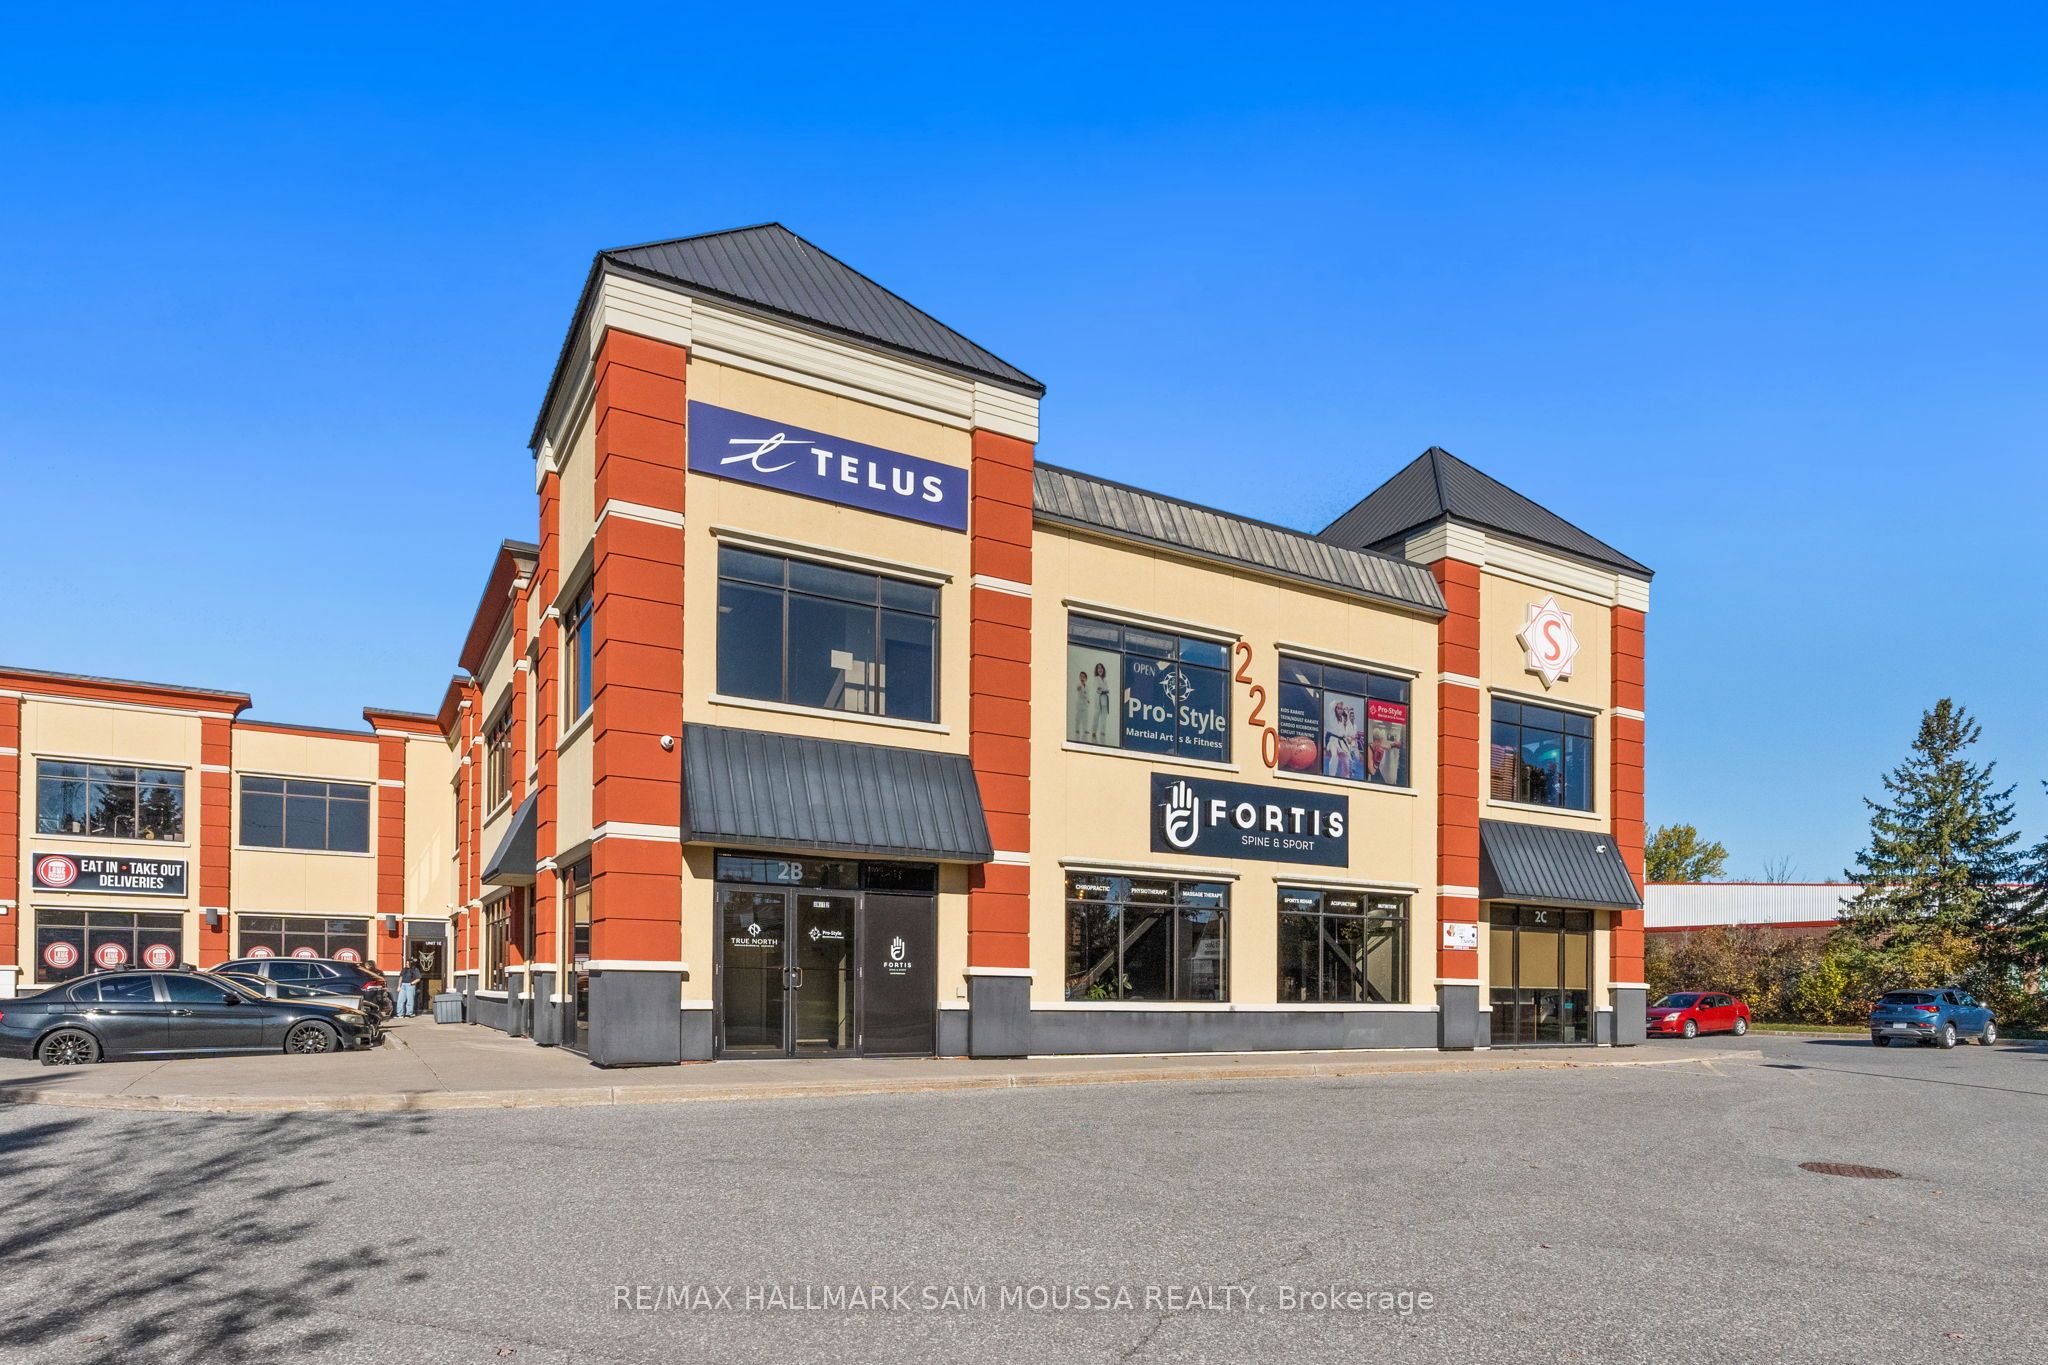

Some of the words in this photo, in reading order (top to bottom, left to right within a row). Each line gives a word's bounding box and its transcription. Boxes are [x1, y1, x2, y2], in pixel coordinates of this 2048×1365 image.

[811, 447, 943, 503] TELUS
[1544, 619, 1561, 661] S
[1133, 662, 1156, 677] OPEN
[1377, 705, 1402, 716] Pro-Style
[1126, 727, 1158, 740] Martial
[1185, 736, 1192, 744] &
[1193, 736, 1223, 749] Fitness
[1211, 799, 1344, 838] FORTIS
[1241, 835, 1270, 847] SPINE
[1273, 839, 1280, 848] &
[1282, 840, 1315, 851] SPORT
[81, 860, 104, 873] EAT
[106, 861, 118, 873] IN
[129, 862, 158, 875] TAKE
[160, 864, 182, 877] OUT
[778, 861, 803, 880] 2B
[99, 875, 164, 889] DELIVERIES
[1131, 887, 1168, 895] PHYSIOTHERAPY
[1534, 910, 1547, 923] 2C
[731, 937, 749, 945] TRUE
